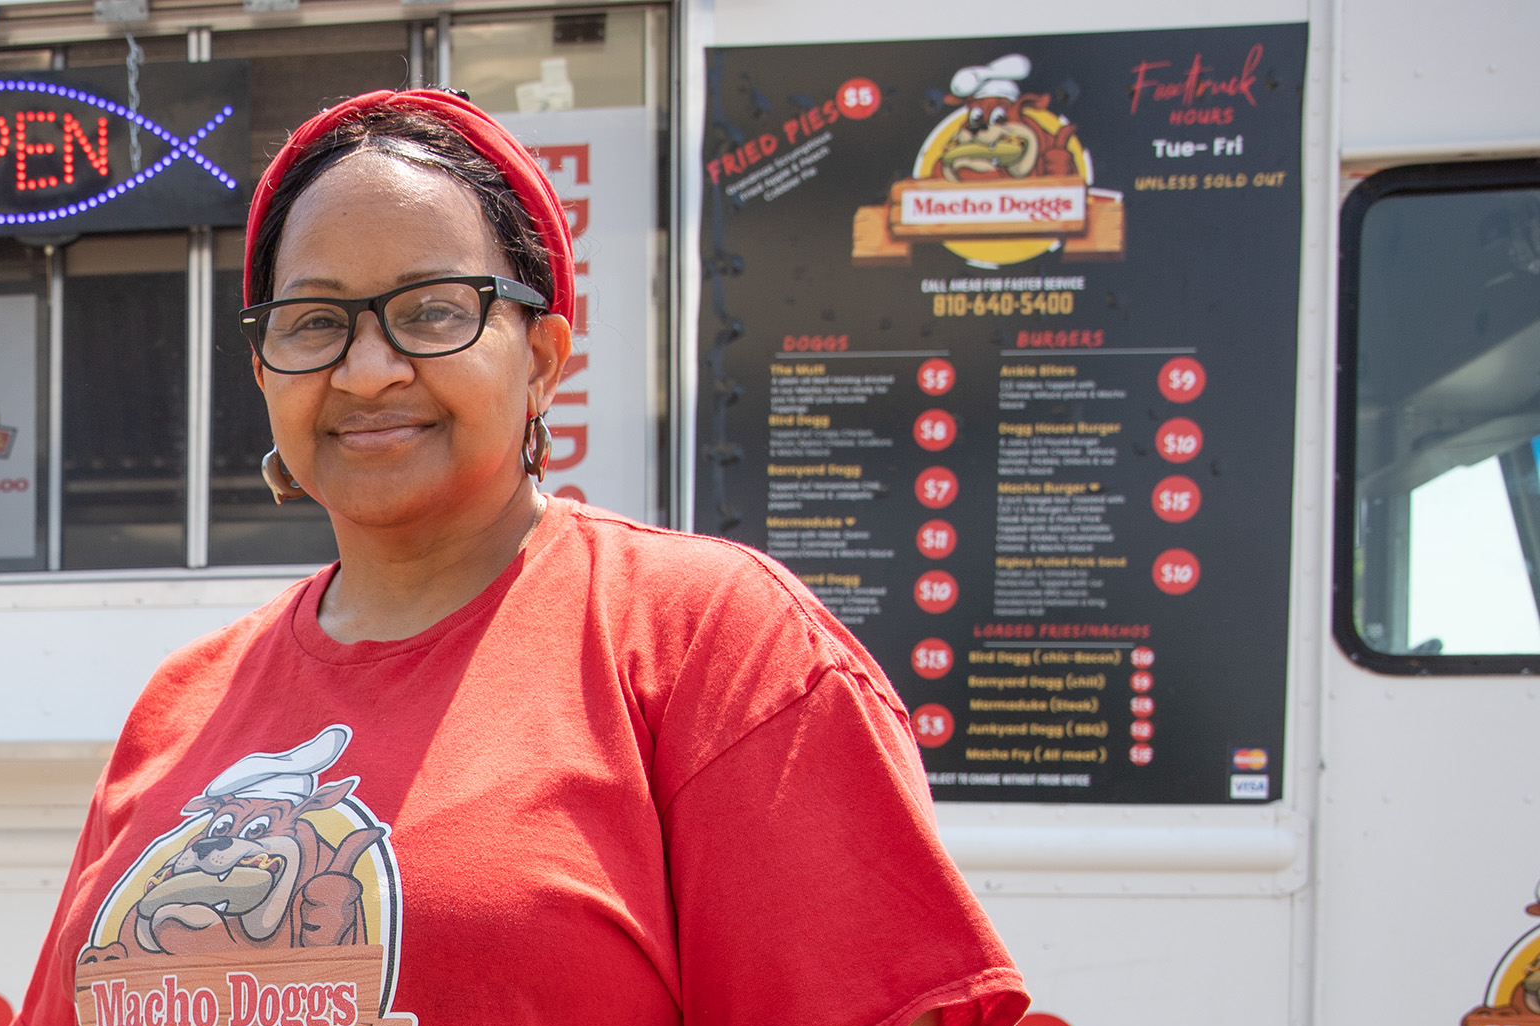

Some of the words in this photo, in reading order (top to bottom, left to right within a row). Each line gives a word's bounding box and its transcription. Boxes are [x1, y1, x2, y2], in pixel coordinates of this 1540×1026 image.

[844, 86, 873, 107] $5
[1169, 106, 1234, 126] HOURS
[706, 133, 778, 184] FRIED
[783, 99, 839, 145] PIES
[1213, 134, 1243, 156] Fri
[1134, 174, 1198, 191] UNLESS
[1203, 172, 1248, 190] SOLD
[1253, 170, 1287, 188] OUT
[913, 196, 992, 217] Macho
[999, 196, 1073, 222] Doggs
[921, 279, 947, 293] CALL
[949, 278, 982, 293] AHEAD
[1004, 277, 1042, 292] FASTER
[1043, 276, 1085, 291] SERVICE
[933, 291, 1074, 316] 810-640-5400
[783, 334, 849, 352] DOGGS
[1016, 329, 1105, 348] BURGERS
[770, 364, 794, 376] The
[922, 368, 949, 390] $5
[1169, 368, 1197, 391] $9
[768, 414, 795, 427] Bird
[796, 414, 830, 429] Dogg
[920, 419, 947, 441] $8
[998, 422, 1033, 437] Dogg
[1034, 422, 1076, 435] House
[1077, 421, 1121, 437] Burger
[1164, 432, 1197, 454] $10
[767, 464, 827, 478] Barnyard
[828, 464, 862, 480] Dogg
[924, 478, 950, 501] $7
[997, 482, 1042, 494] Macho
[1043, 482, 1087, 496] Burger
[922, 528, 949, 550] $11
[827, 573, 861, 588] Dogg
[1160, 563, 1194, 584] $10
[920, 580, 952, 602] $10
[973, 624, 1035, 639] LOADED
[996, 651, 1032, 667] Dogg
[1029, 675, 1064, 691] Dogg
[1029, 723, 1064, 739] Dogg
[1234, 780, 1265, 792] VISA
